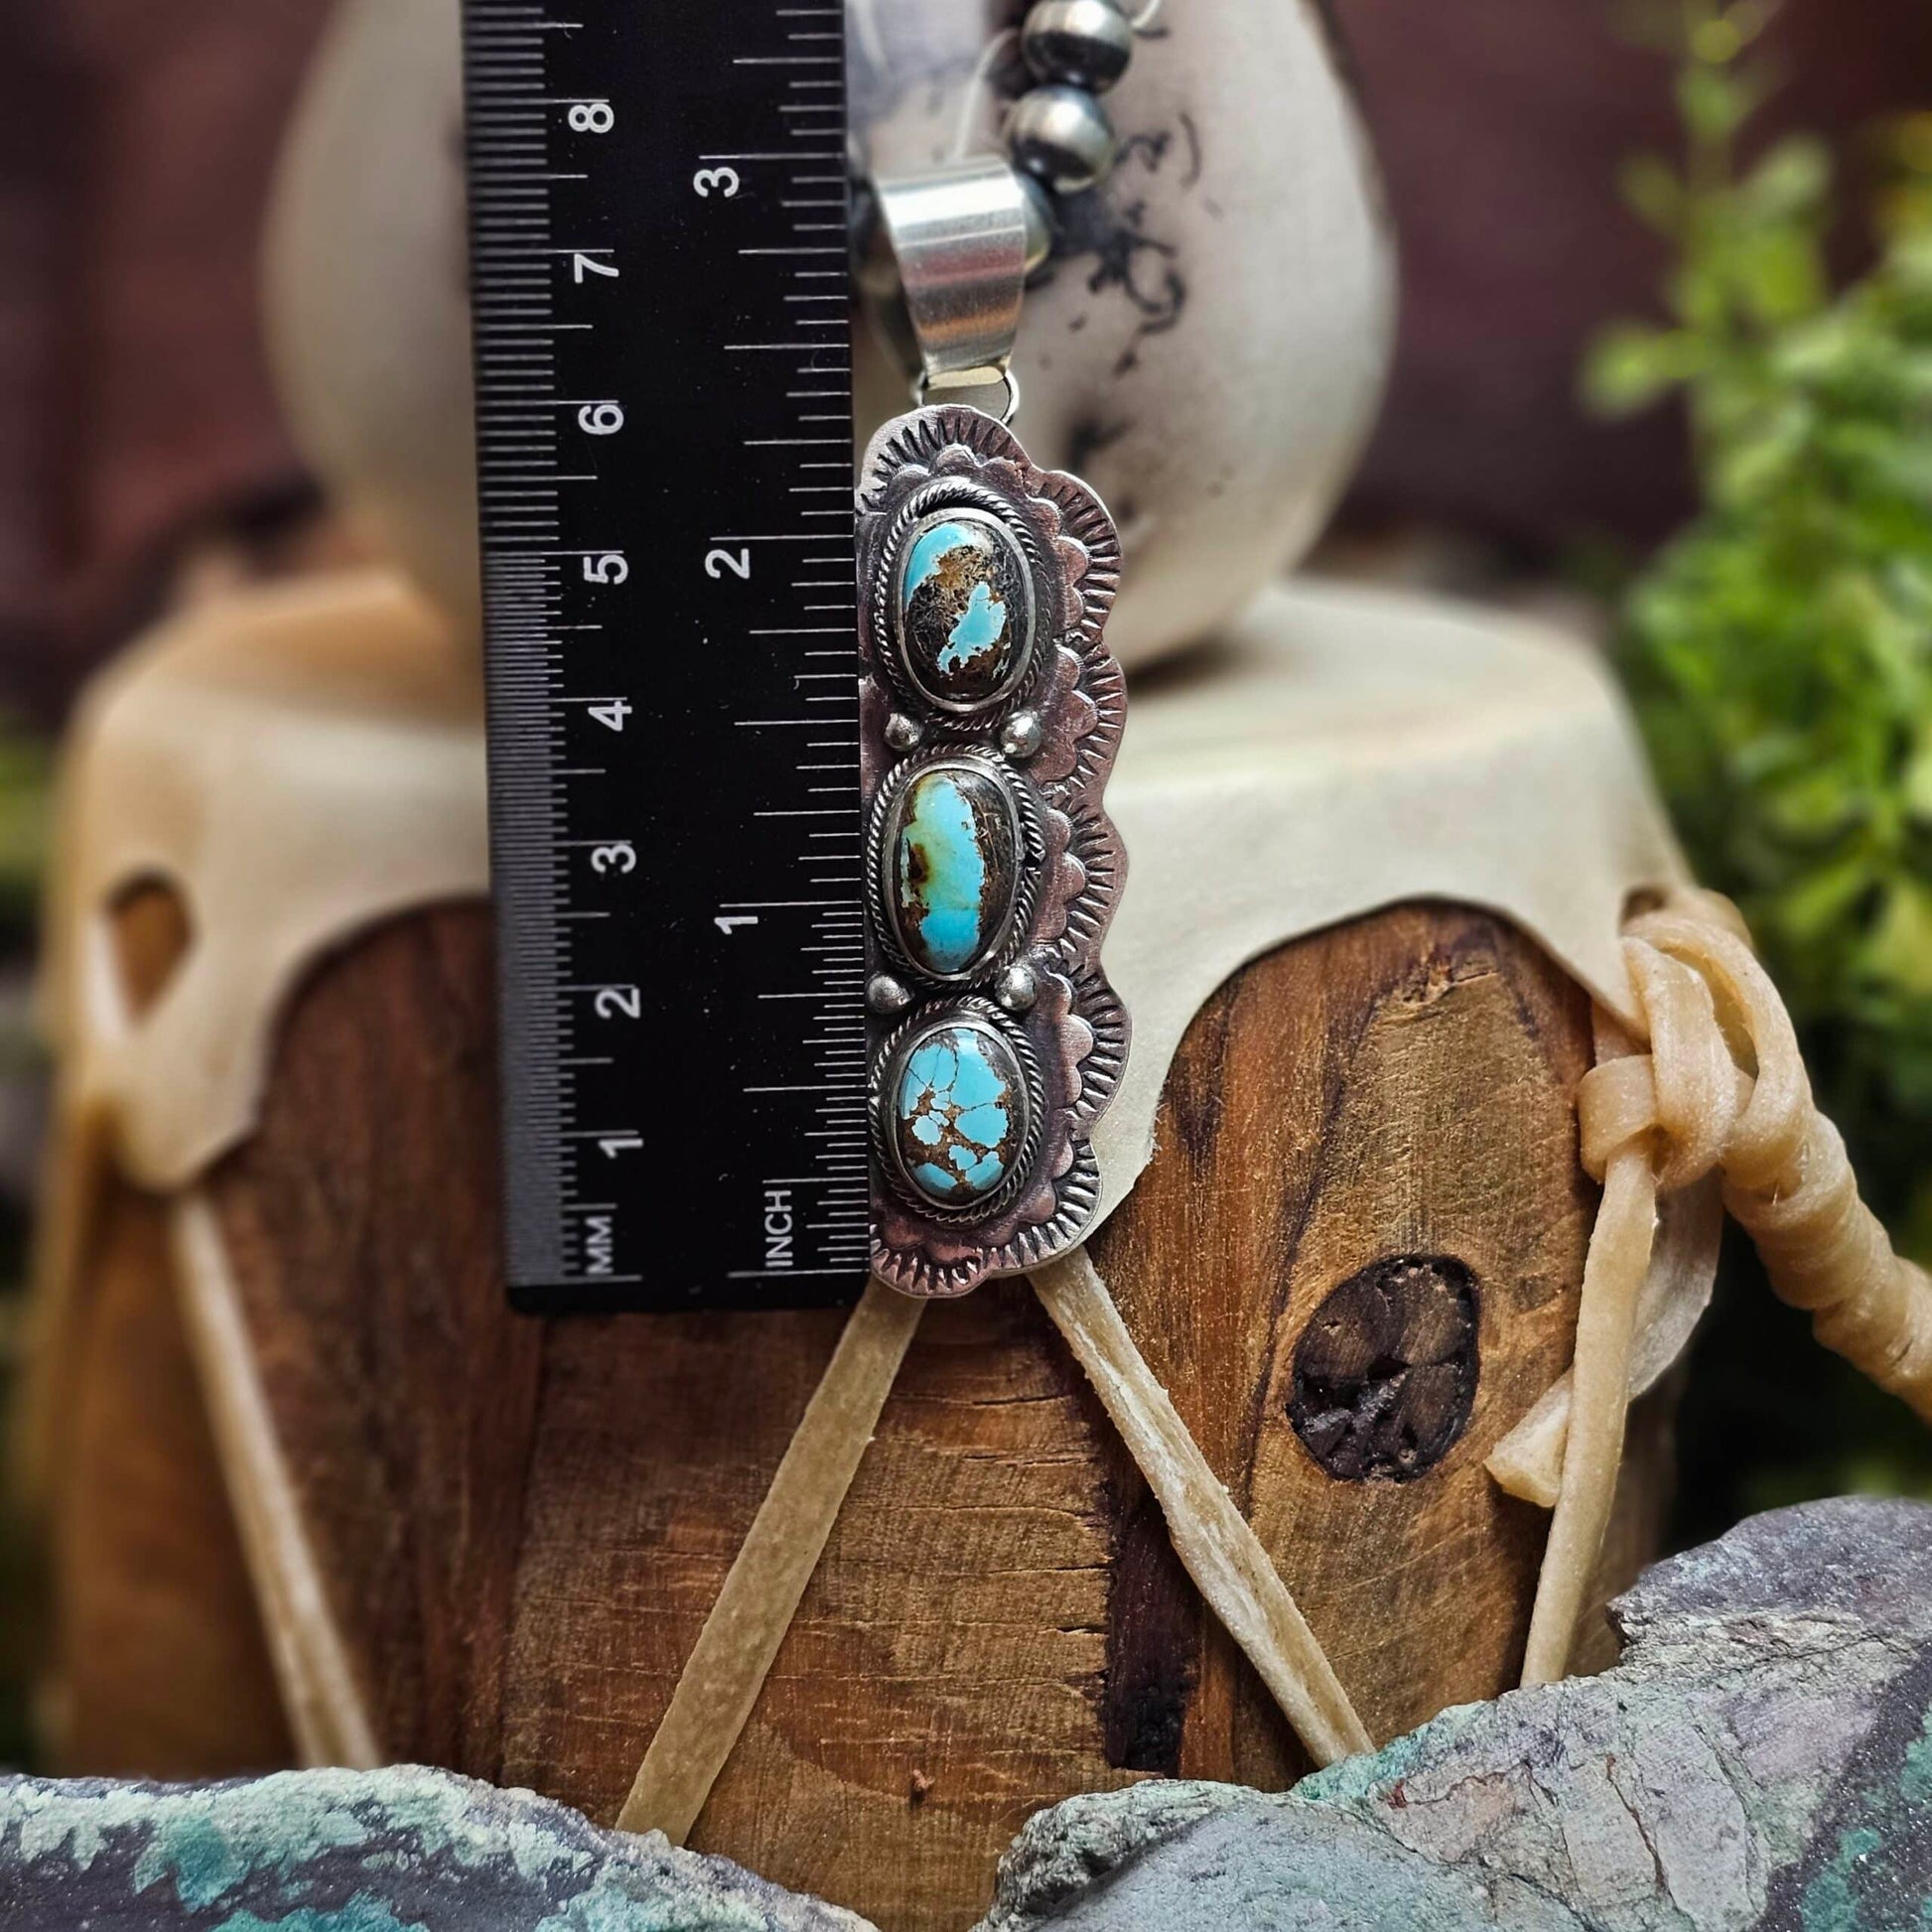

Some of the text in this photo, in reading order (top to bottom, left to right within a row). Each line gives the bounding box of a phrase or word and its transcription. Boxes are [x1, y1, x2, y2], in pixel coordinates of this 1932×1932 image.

[568, 102, 615, 134] 8
[693, 167, 739, 198] 3
[574, 253, 620, 284] 7
[578, 404, 624, 436] 6
[583, 554, 629, 585] 5
[705, 548, 750, 580] 2
[588, 701, 632, 732] 4
[591, 844, 636, 874] 3
[714, 916, 759, 935] 1
[595, 988, 640, 1019] 2
[598, 1139, 643, 1159] 1
[764, 1190, 793, 1268] INCH
[585, 1216, 614, 1275] MM
